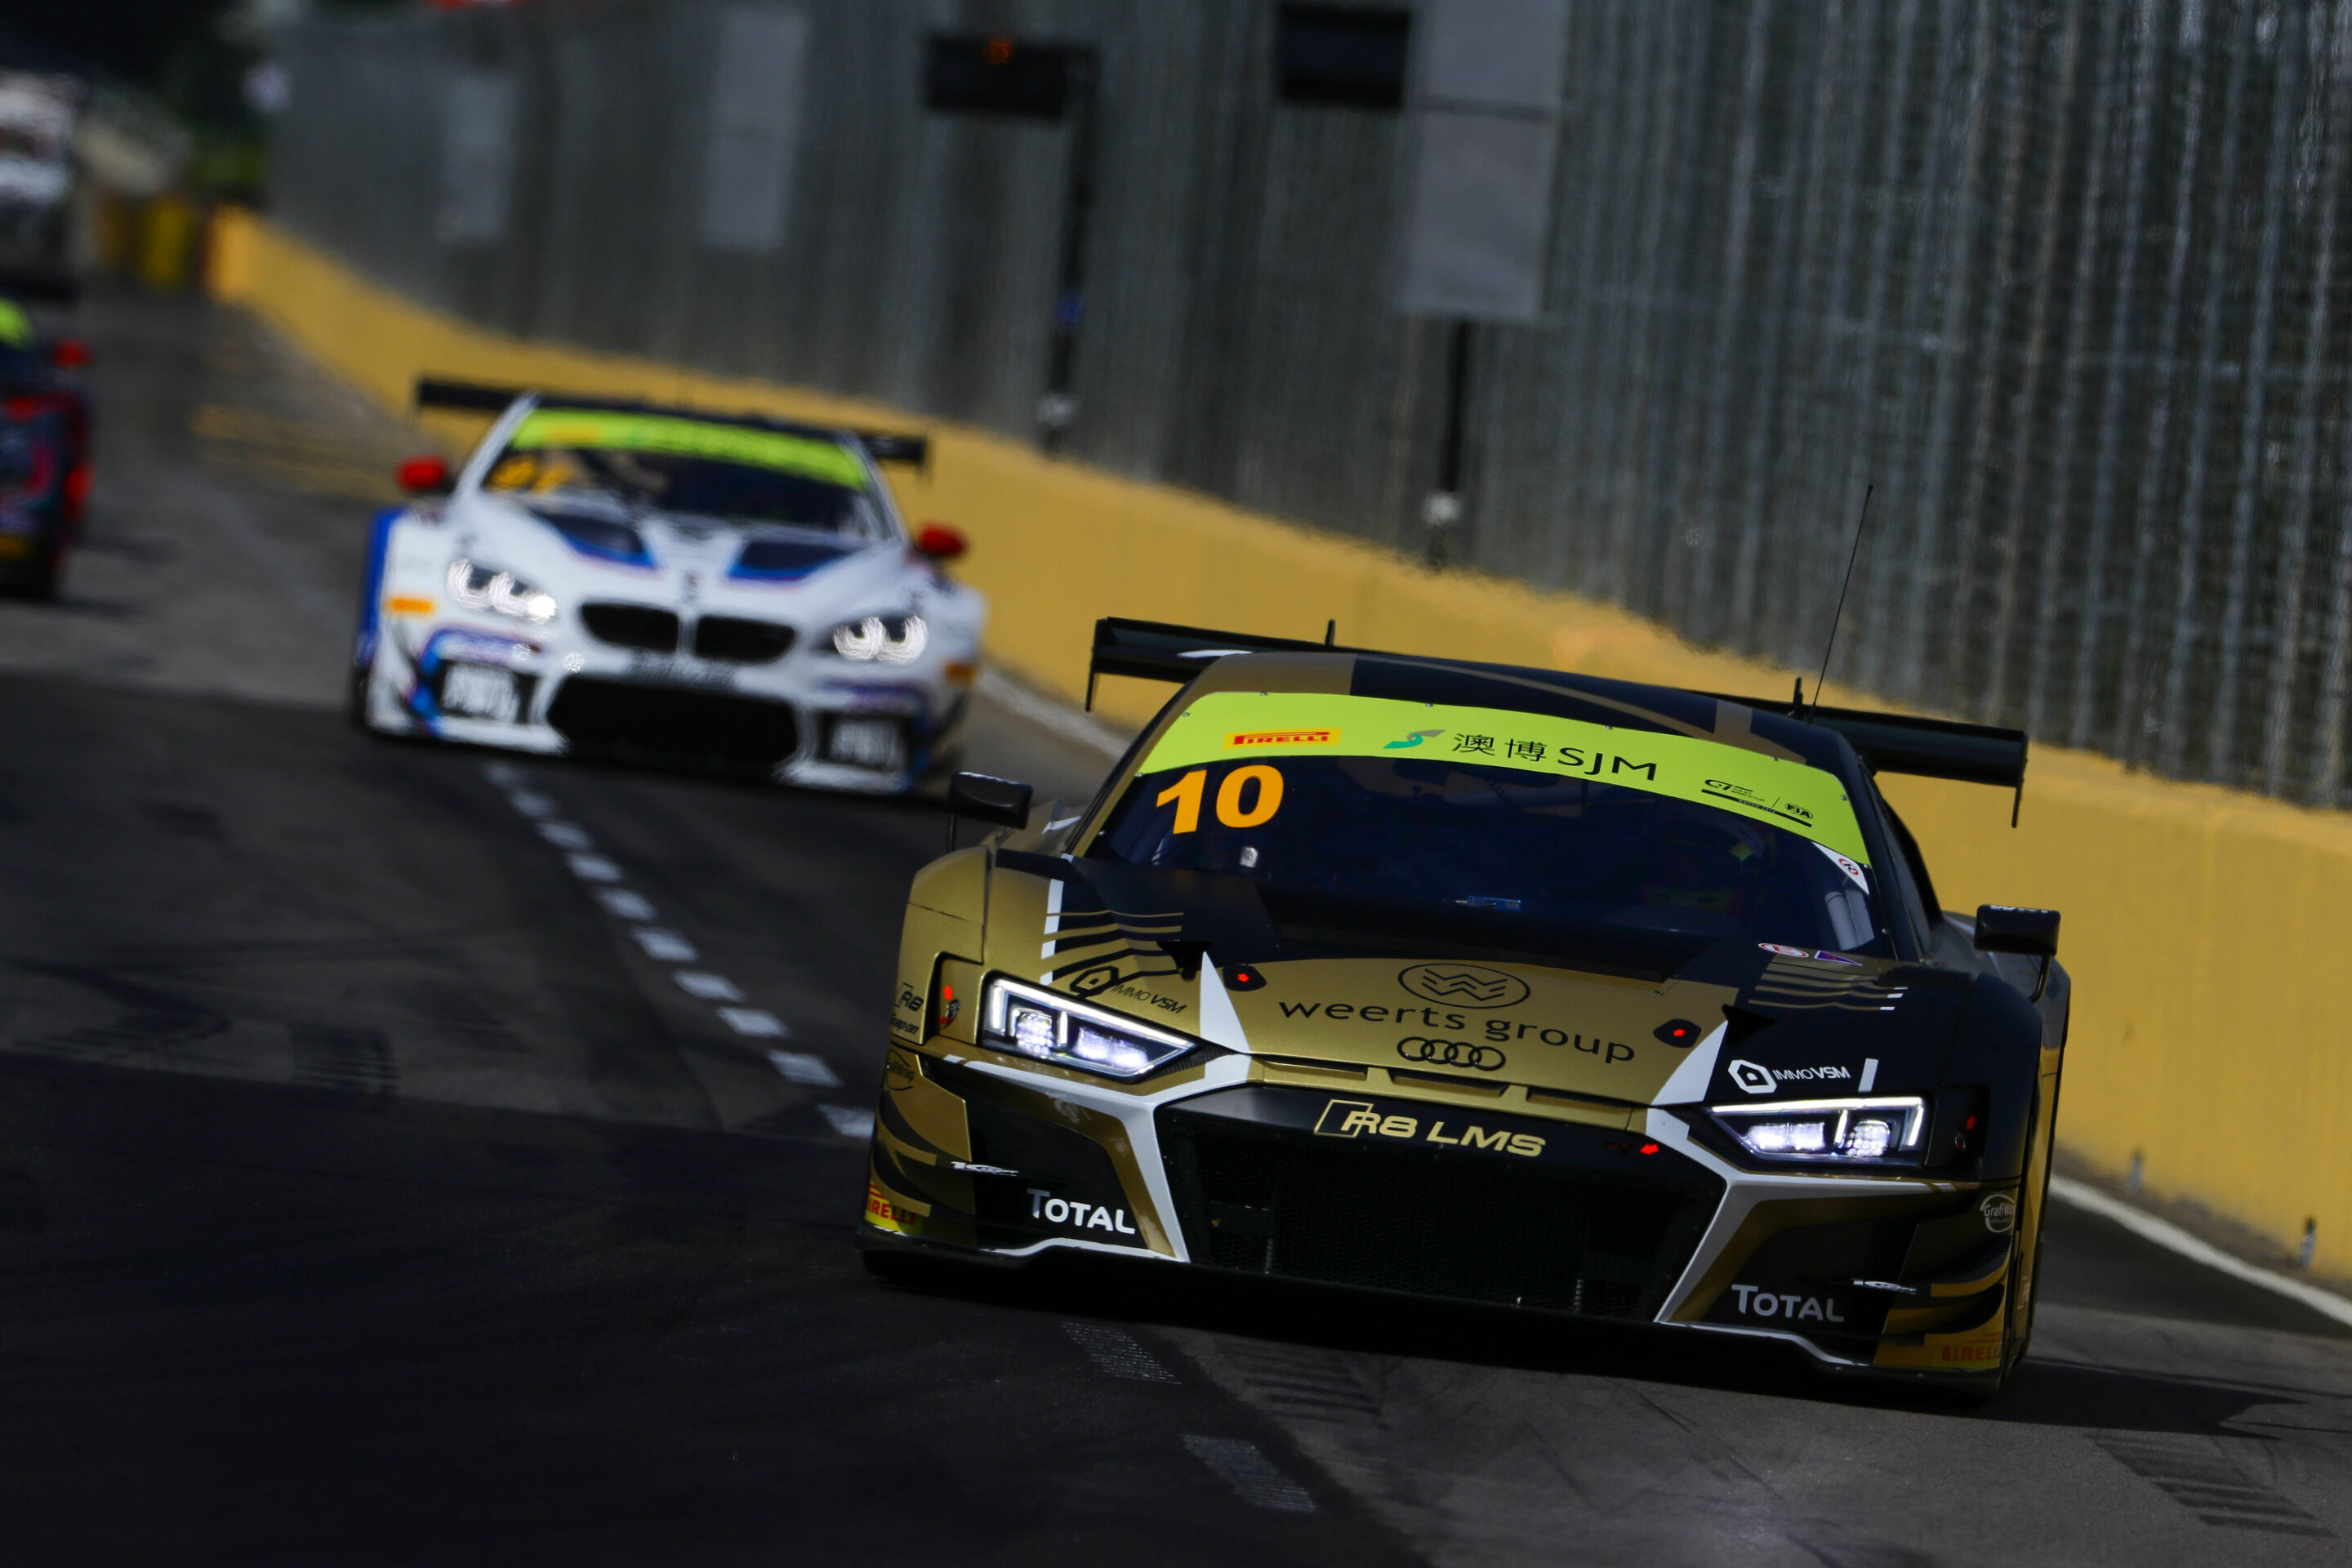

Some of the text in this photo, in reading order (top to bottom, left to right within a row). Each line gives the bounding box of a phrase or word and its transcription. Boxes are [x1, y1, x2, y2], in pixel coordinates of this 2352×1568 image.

[1234, 732, 1330, 745] PIRELLI
[1557, 746, 1658, 782] SJM
[1156, 764, 1285, 835] 10
[1279, 1000, 1635, 1063] weerts group
[1339, 1110, 1547, 1157] R8 LMS
[1026, 1187, 1136, 1235] TOTAL
[1731, 1284, 1845, 1323] TOTAL
